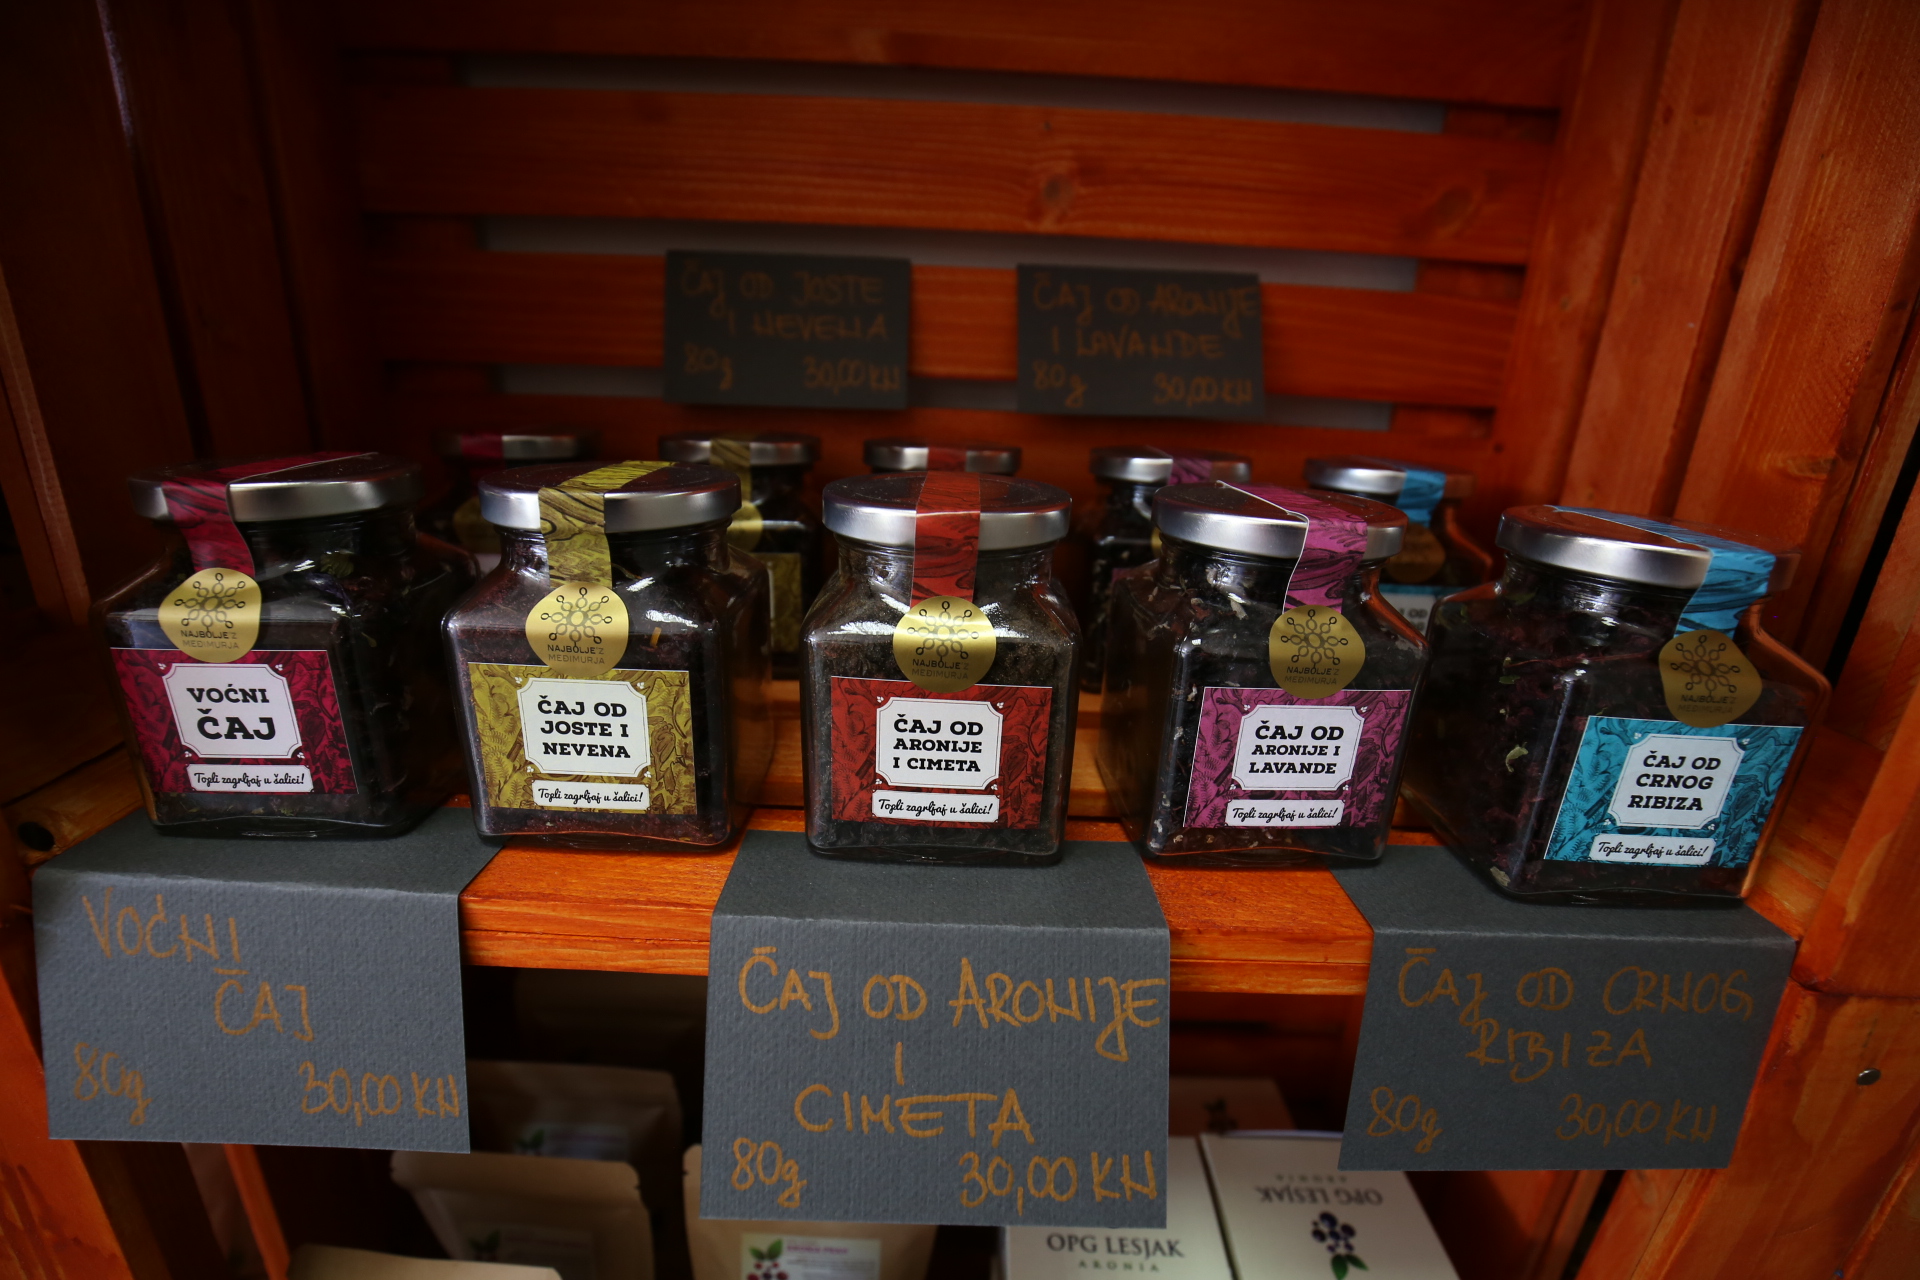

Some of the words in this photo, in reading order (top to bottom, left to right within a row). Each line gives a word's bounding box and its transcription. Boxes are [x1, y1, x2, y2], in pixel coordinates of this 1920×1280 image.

[739, 271, 774, 299] OD
[793, 270, 884, 306] JOSTE
[1033, 272, 1092, 327] ČAJ
[1106, 286, 1140, 316] OD
[1149, 282, 1259, 339] ARONIJE
[1076, 324, 1224, 360] LAVANDE
[683, 342, 734, 391] 80g
[1032, 359, 1087, 408] 80g
[186, 683, 270, 704] VOĆNI
[537, 695, 585, 716] ČAJ
[593, 701, 627, 717] OD
[197, 709, 277, 741] ČAJ
[540, 720, 612, 737] JOSTE
[620, 723, 629, 738] I
[893, 714, 942, 735] ČAJ
[949, 720, 983, 736] OD
[1255, 720, 1303, 741] ČAJ
[1310, 725, 1344, 741] OD
[542, 742, 631, 759] NEVENA
[893, 738, 983, 754] ARONIJE
[1251, 744, 1328, 756] ARONIJE
[1333, 745, 1341, 757] I
[893, 757, 900, 769] I
[906, 757, 981, 772] CIMETA
[1248, 762, 1337, 774] LAVANDE
[1643, 750, 1686, 769] ČAJ
[1691, 756, 1721, 771] OD
[194, 772, 220, 787] Topli
[221, 772, 261, 789] zagrljaj
[264, 777, 272, 785] u
[273, 773, 305, 785] šalici!
[1636, 773, 1714, 790] CRNOG
[538, 788, 562, 802] Topli
[564, 789, 602, 804] zagrljaj
[612, 791, 644, 802] šalici!
[1627, 794, 1704, 811] RIBIZA
[878, 798, 904, 814] Topli
[906, 800, 948, 817] zagrljaj
[959, 802, 993, 815] šalici!
[1232, 807, 1256, 822] Topli
[1258, 807, 1296, 823] zagrljaj
[1307, 807, 1339, 819] šalici!
[1598, 841, 1623, 857] Topli
[1624, 843, 1665, 859] zagrljaj
[1675, 845, 1709, 857] šalici!
[81, 886, 243, 963] VOĆNI
[1398, 946, 1490, 1028] ČAJ
[1515, 967, 1575, 1011] OD
[214, 967, 314, 1042] ČAJ
[738, 945, 841, 1040] ČAJ
[862, 974, 928, 1020] OD
[948, 957, 1167, 1061] ARONIJE
[1465, 1017, 1654, 1083] RIBIZA
[894, 1041, 905, 1086] I
[73, 1042, 153, 1126] 80g
[299, 1060, 403, 1128] 30,00
[410, 1071, 460, 1119] KN
[793, 1083, 1035, 1148] CIMETA
[1366, 1085, 1444, 1154] 80g
[1555, 1092, 1660, 1148] 30,00
[1664, 1098, 1718, 1146] KN
[730, 1136, 808, 1209] 80g
[957, 1150, 1079, 1216] 30,00
[1090, 1149, 1158, 1202] KN
[1255, 1185, 1331, 1204] LESJAK
[1334, 1187, 1383, 1205] OPG
[1047, 1232, 1098, 1254] OPG
[1105, 1236, 1185, 1260] LESJAK
[1078, 1259, 1160, 1272] ARONIA
